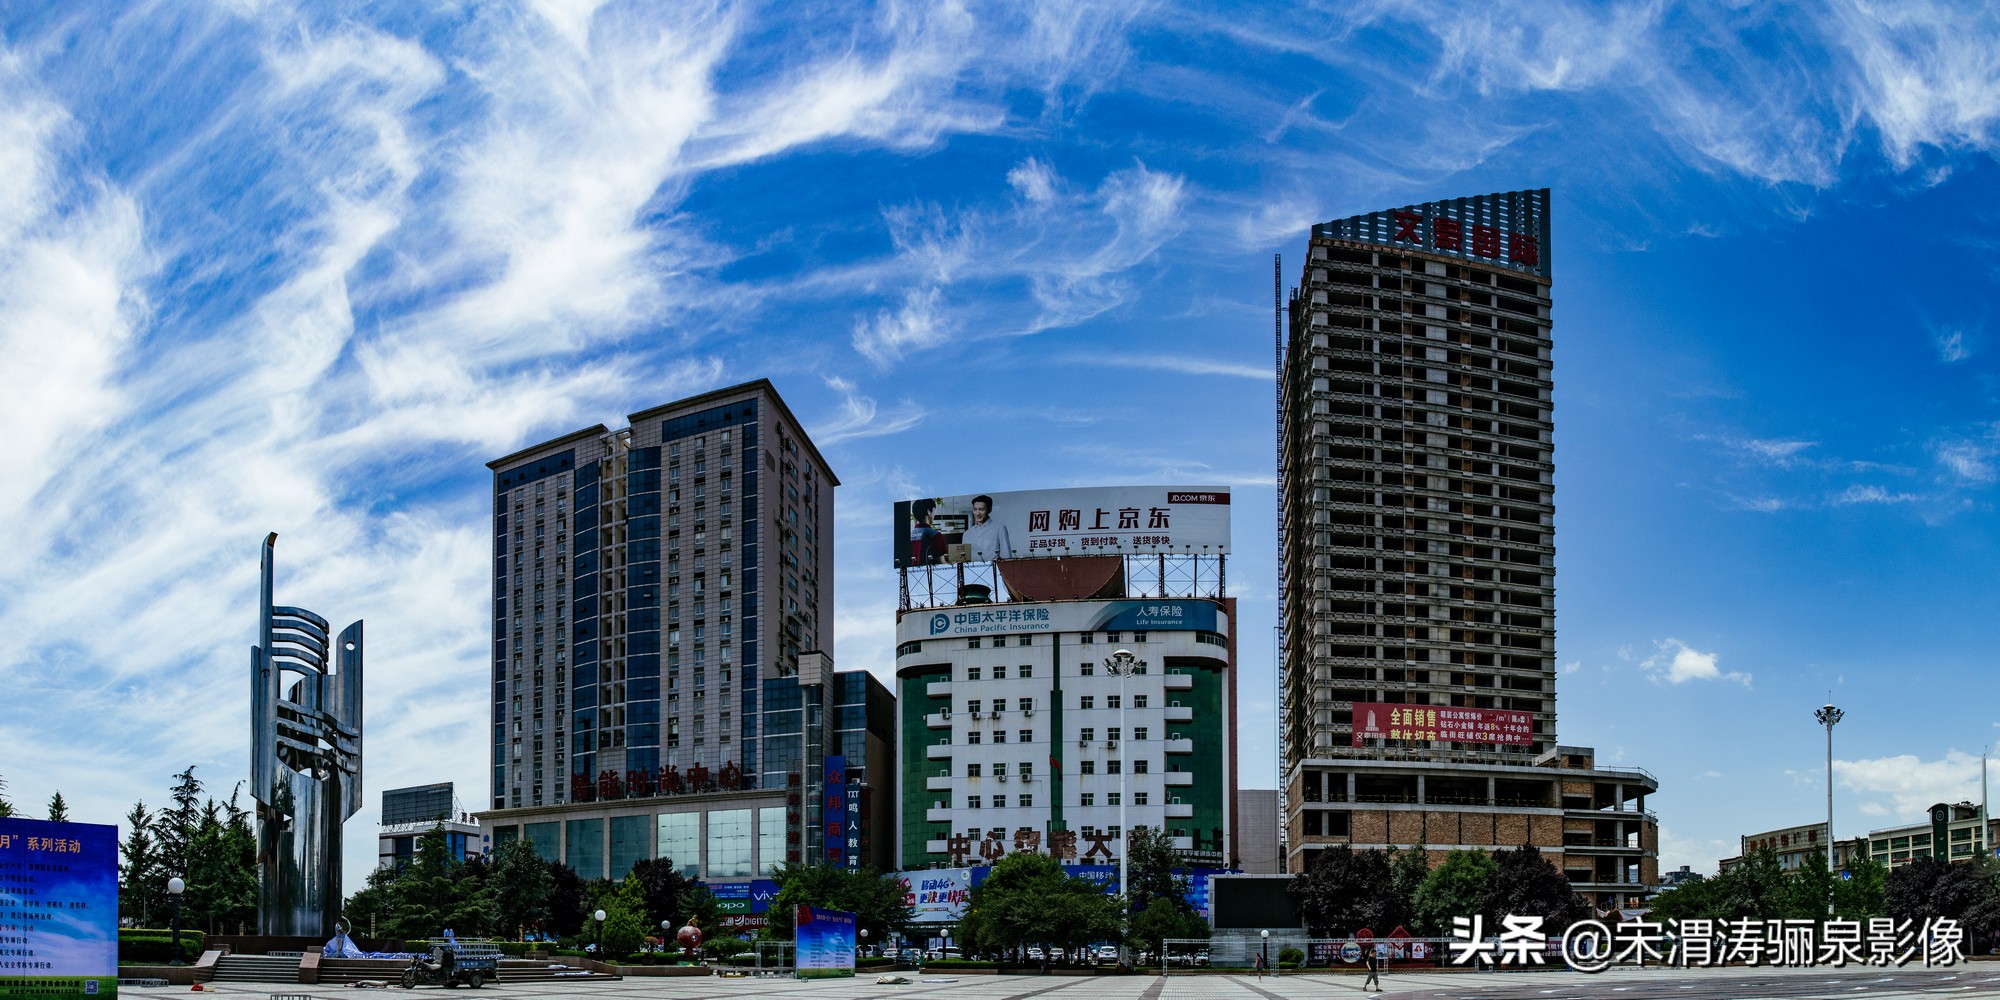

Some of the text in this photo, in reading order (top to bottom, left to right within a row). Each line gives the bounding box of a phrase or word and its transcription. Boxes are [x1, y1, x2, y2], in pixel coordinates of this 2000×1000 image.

[1171, 494, 1216, 502] JD.COM 京东
[1029, 507, 1171, 532] 网购上京东
[1030, 535, 1171, 549] 正品好货 货到付款 送货够快
[954, 605, 1183, 626] 中国太平洋保险 人寿保险
[954, 622, 1050, 634] China Pacific Insurance
[1390, 707, 1437, 728] 全面销售
[948, 829, 1145, 862] 中心智能大
